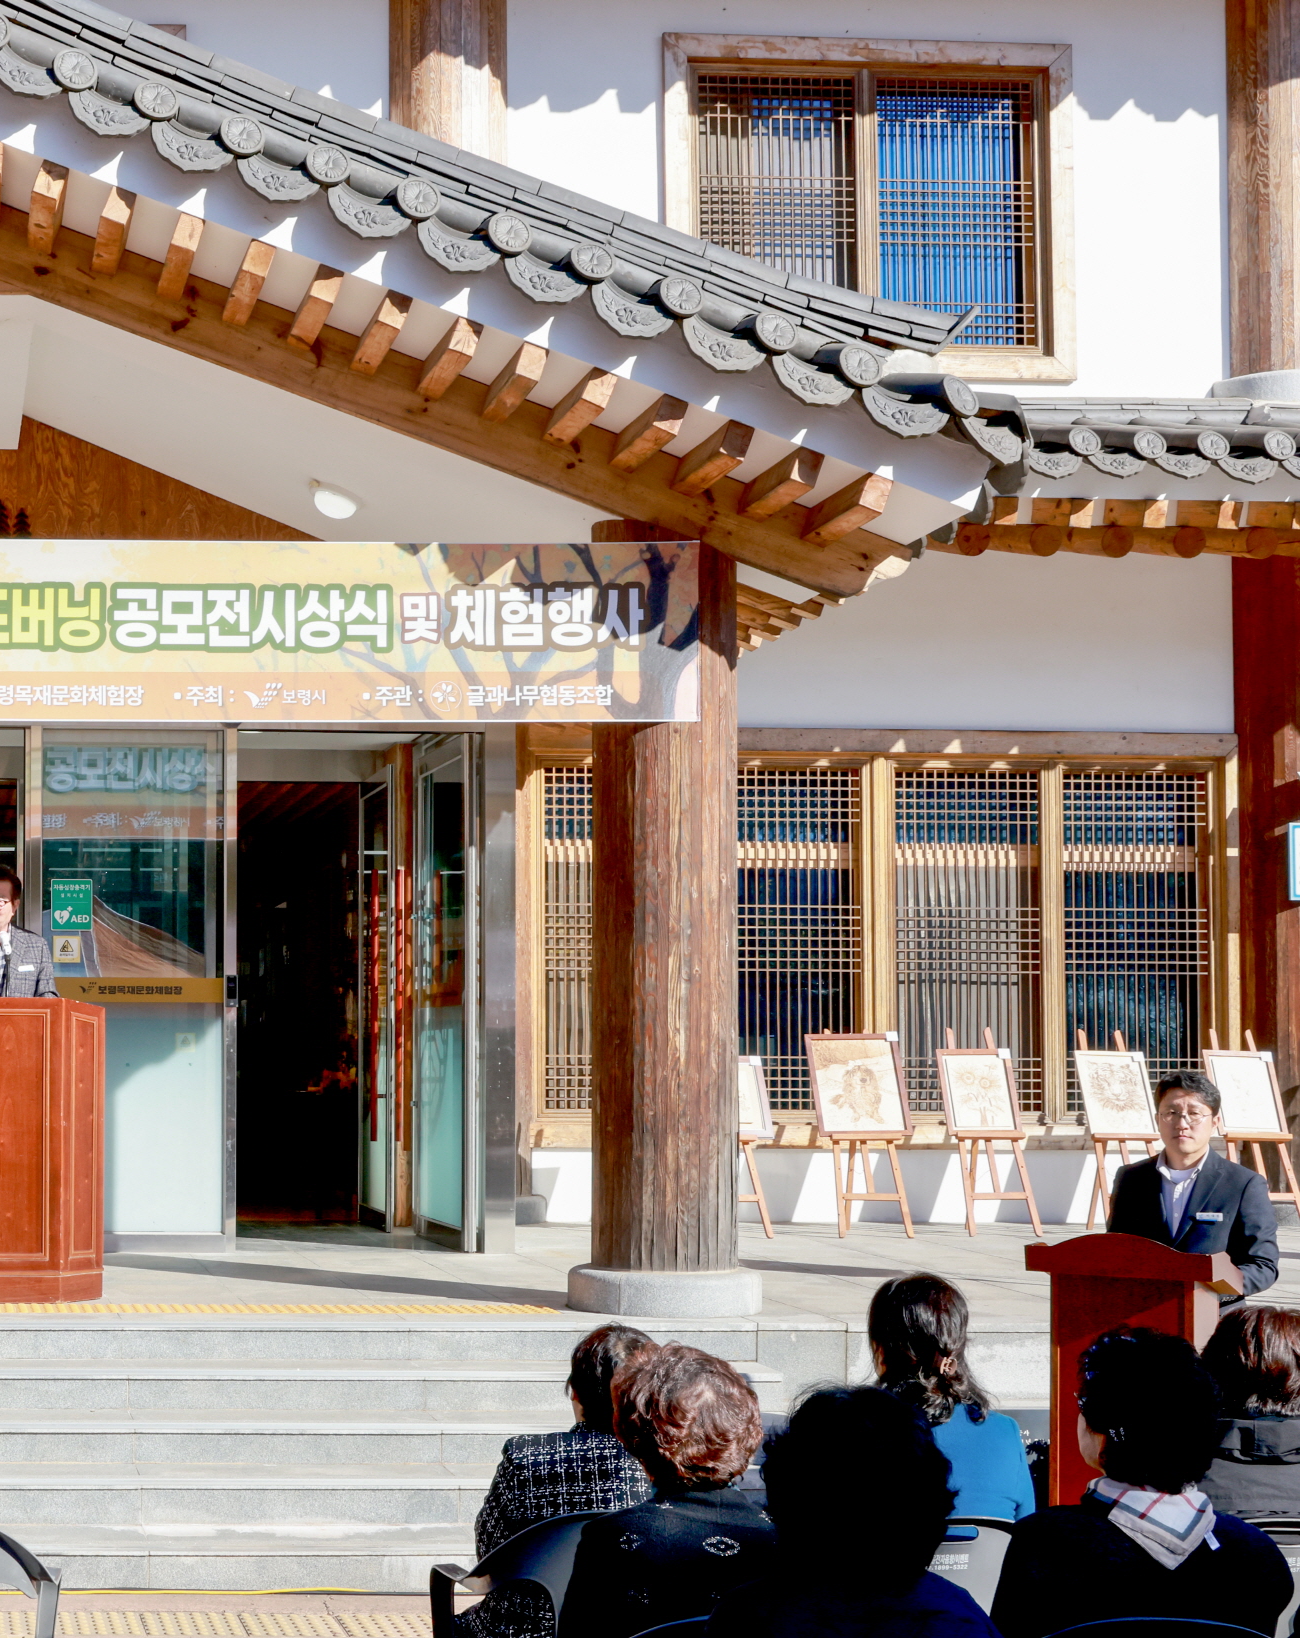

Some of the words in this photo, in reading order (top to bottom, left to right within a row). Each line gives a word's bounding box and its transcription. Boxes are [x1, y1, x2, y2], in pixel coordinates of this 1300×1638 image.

[111, 584, 389, 650] 공모전시상식
[402, 593, 442, 643] 및
[448, 585, 646, 648] 체험행사
[185, 685, 225, 706] 주최
[281, 688, 327, 706] 보령시
[374, 685, 413, 706] 주관
[466, 684, 614, 707] 글과나무협동조합
[70, 914, 90, 923] AED
[98, 985, 183, 996] 보령목재문화체험장
